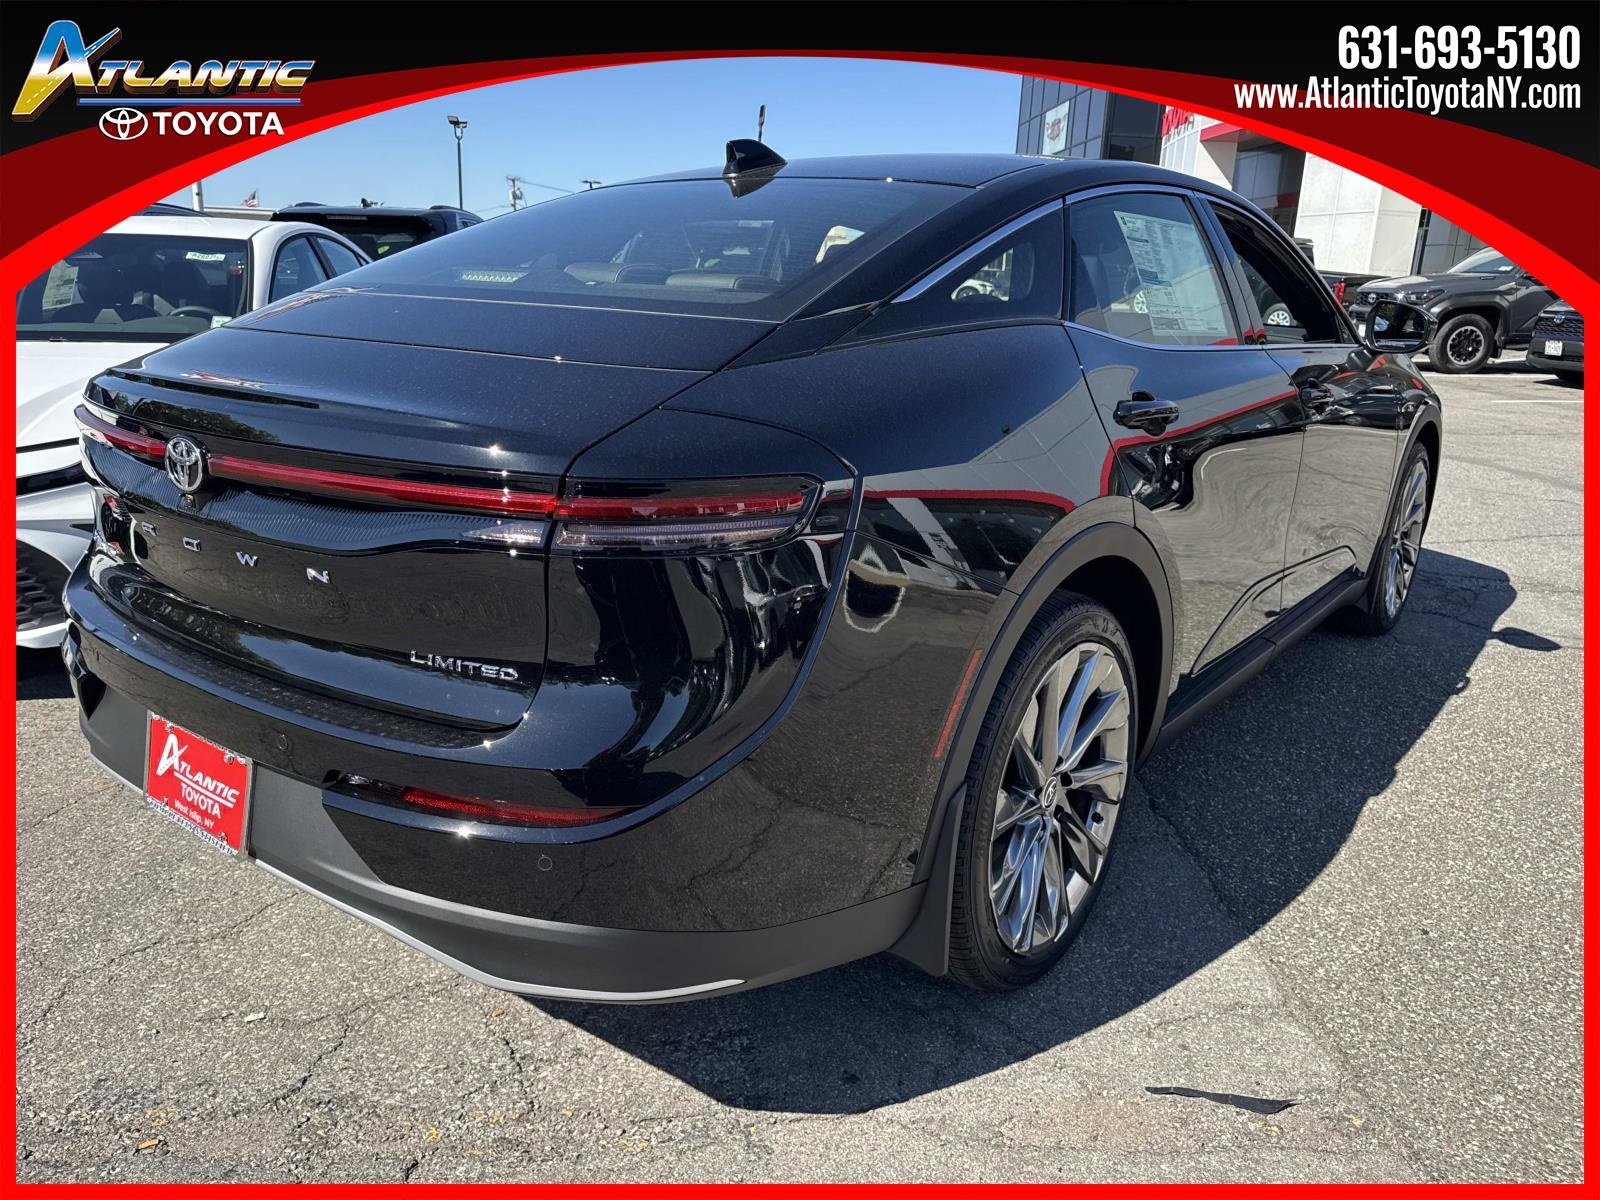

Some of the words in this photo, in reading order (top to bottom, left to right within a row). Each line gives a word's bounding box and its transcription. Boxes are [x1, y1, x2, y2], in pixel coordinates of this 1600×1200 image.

[410, 650, 519, 680] LIMITED
[174, 799, 189, 815] West
[204, 817, 215, 830] NY
[181, 783, 222, 819] TOYOTA
